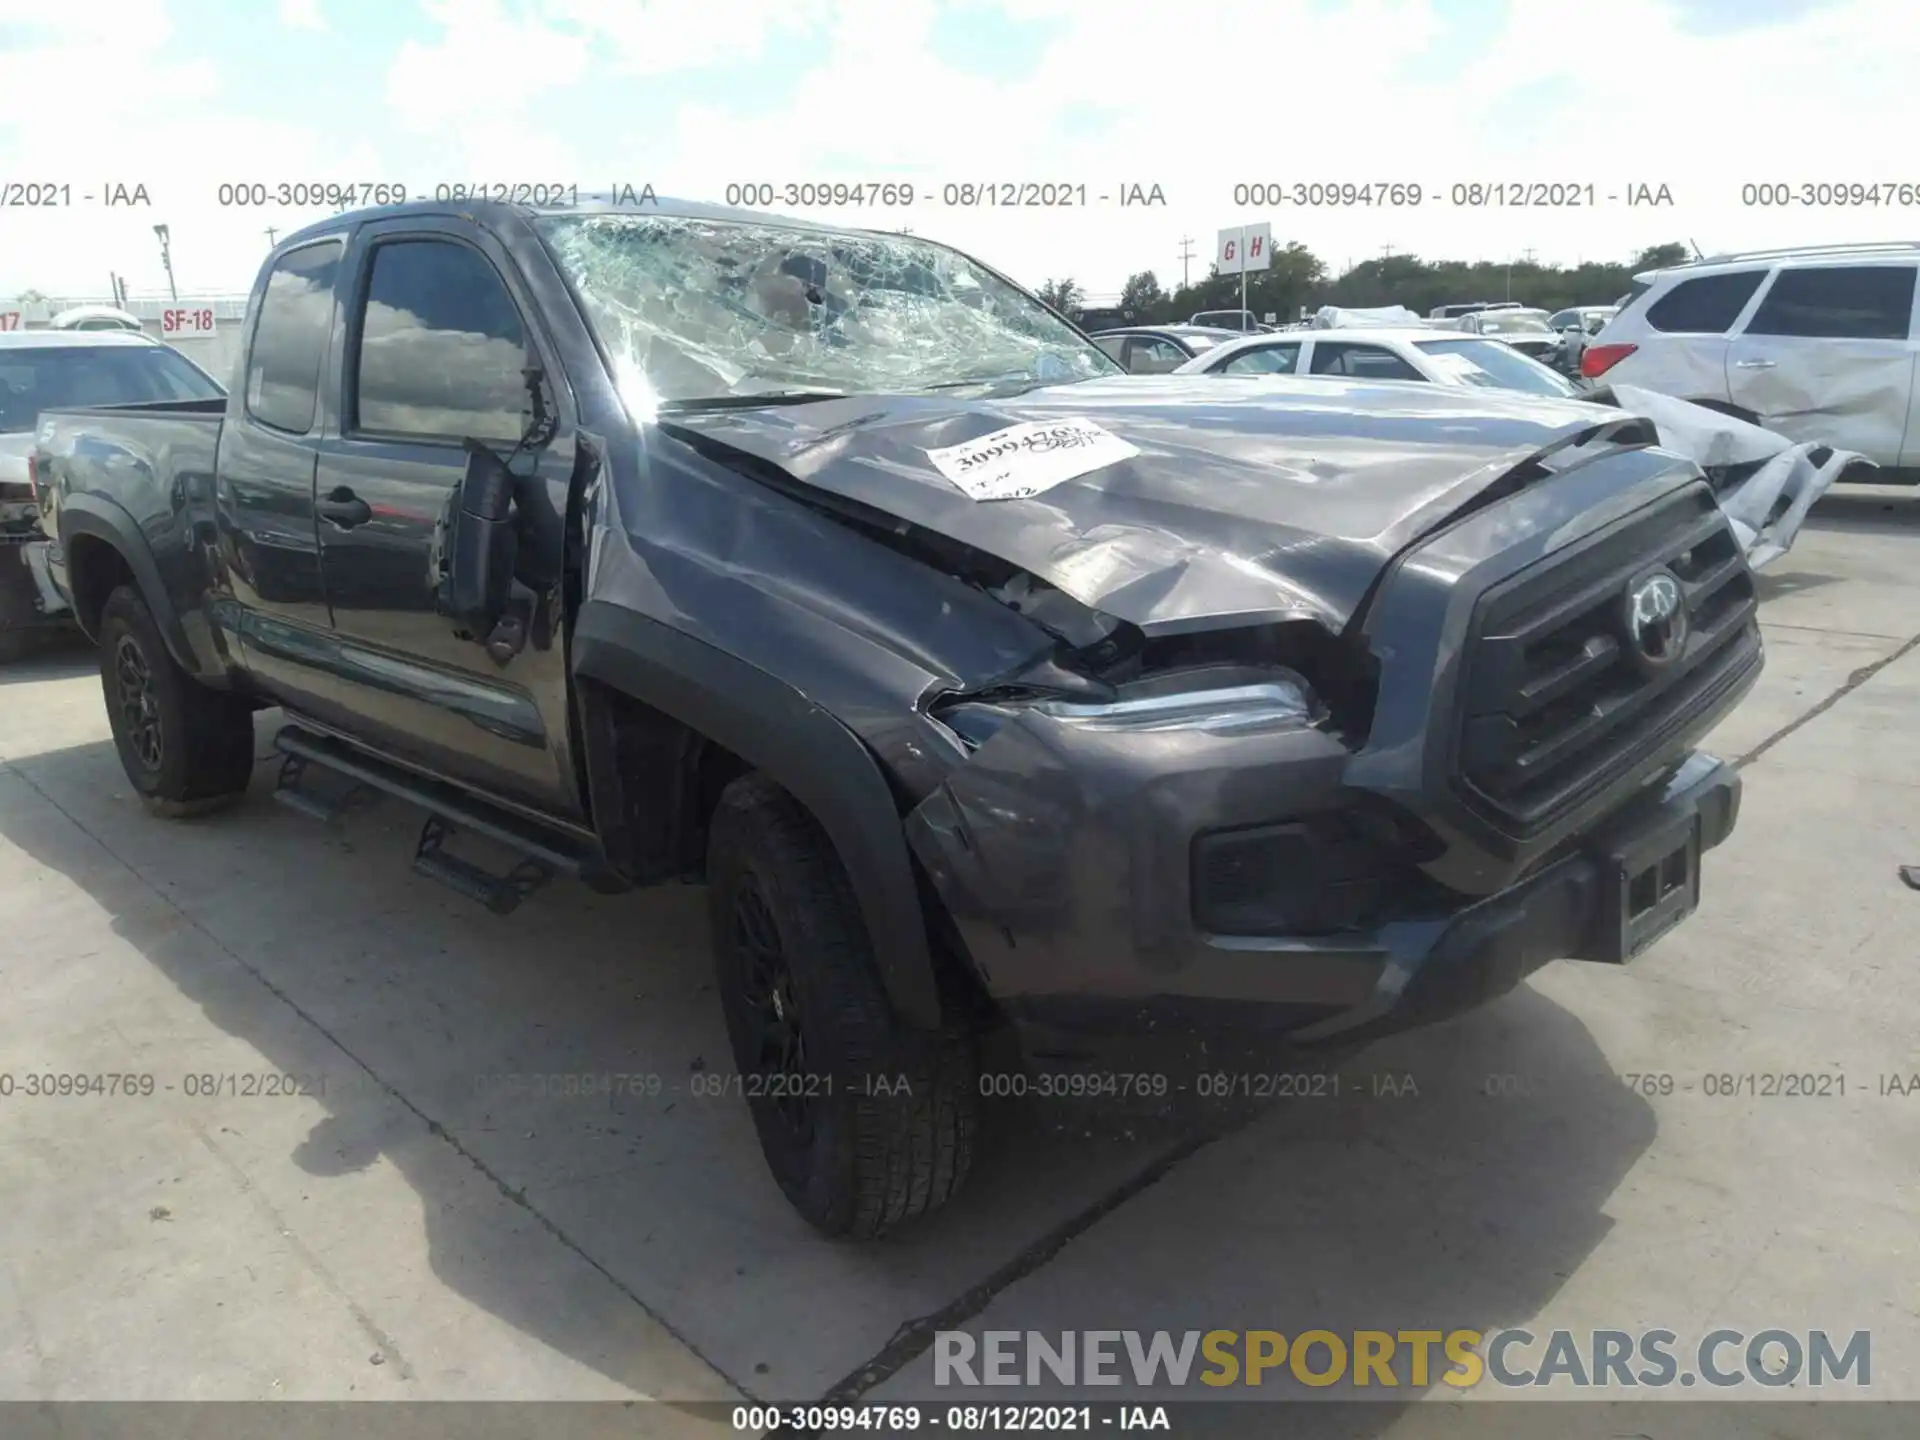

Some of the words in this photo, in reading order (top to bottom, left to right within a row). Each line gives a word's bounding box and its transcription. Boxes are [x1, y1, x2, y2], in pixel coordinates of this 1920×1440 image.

[1224, 240, 1236, 261] G
[1250, 236, 1263, 258] H
[163, 309, 213, 331] SF-18
